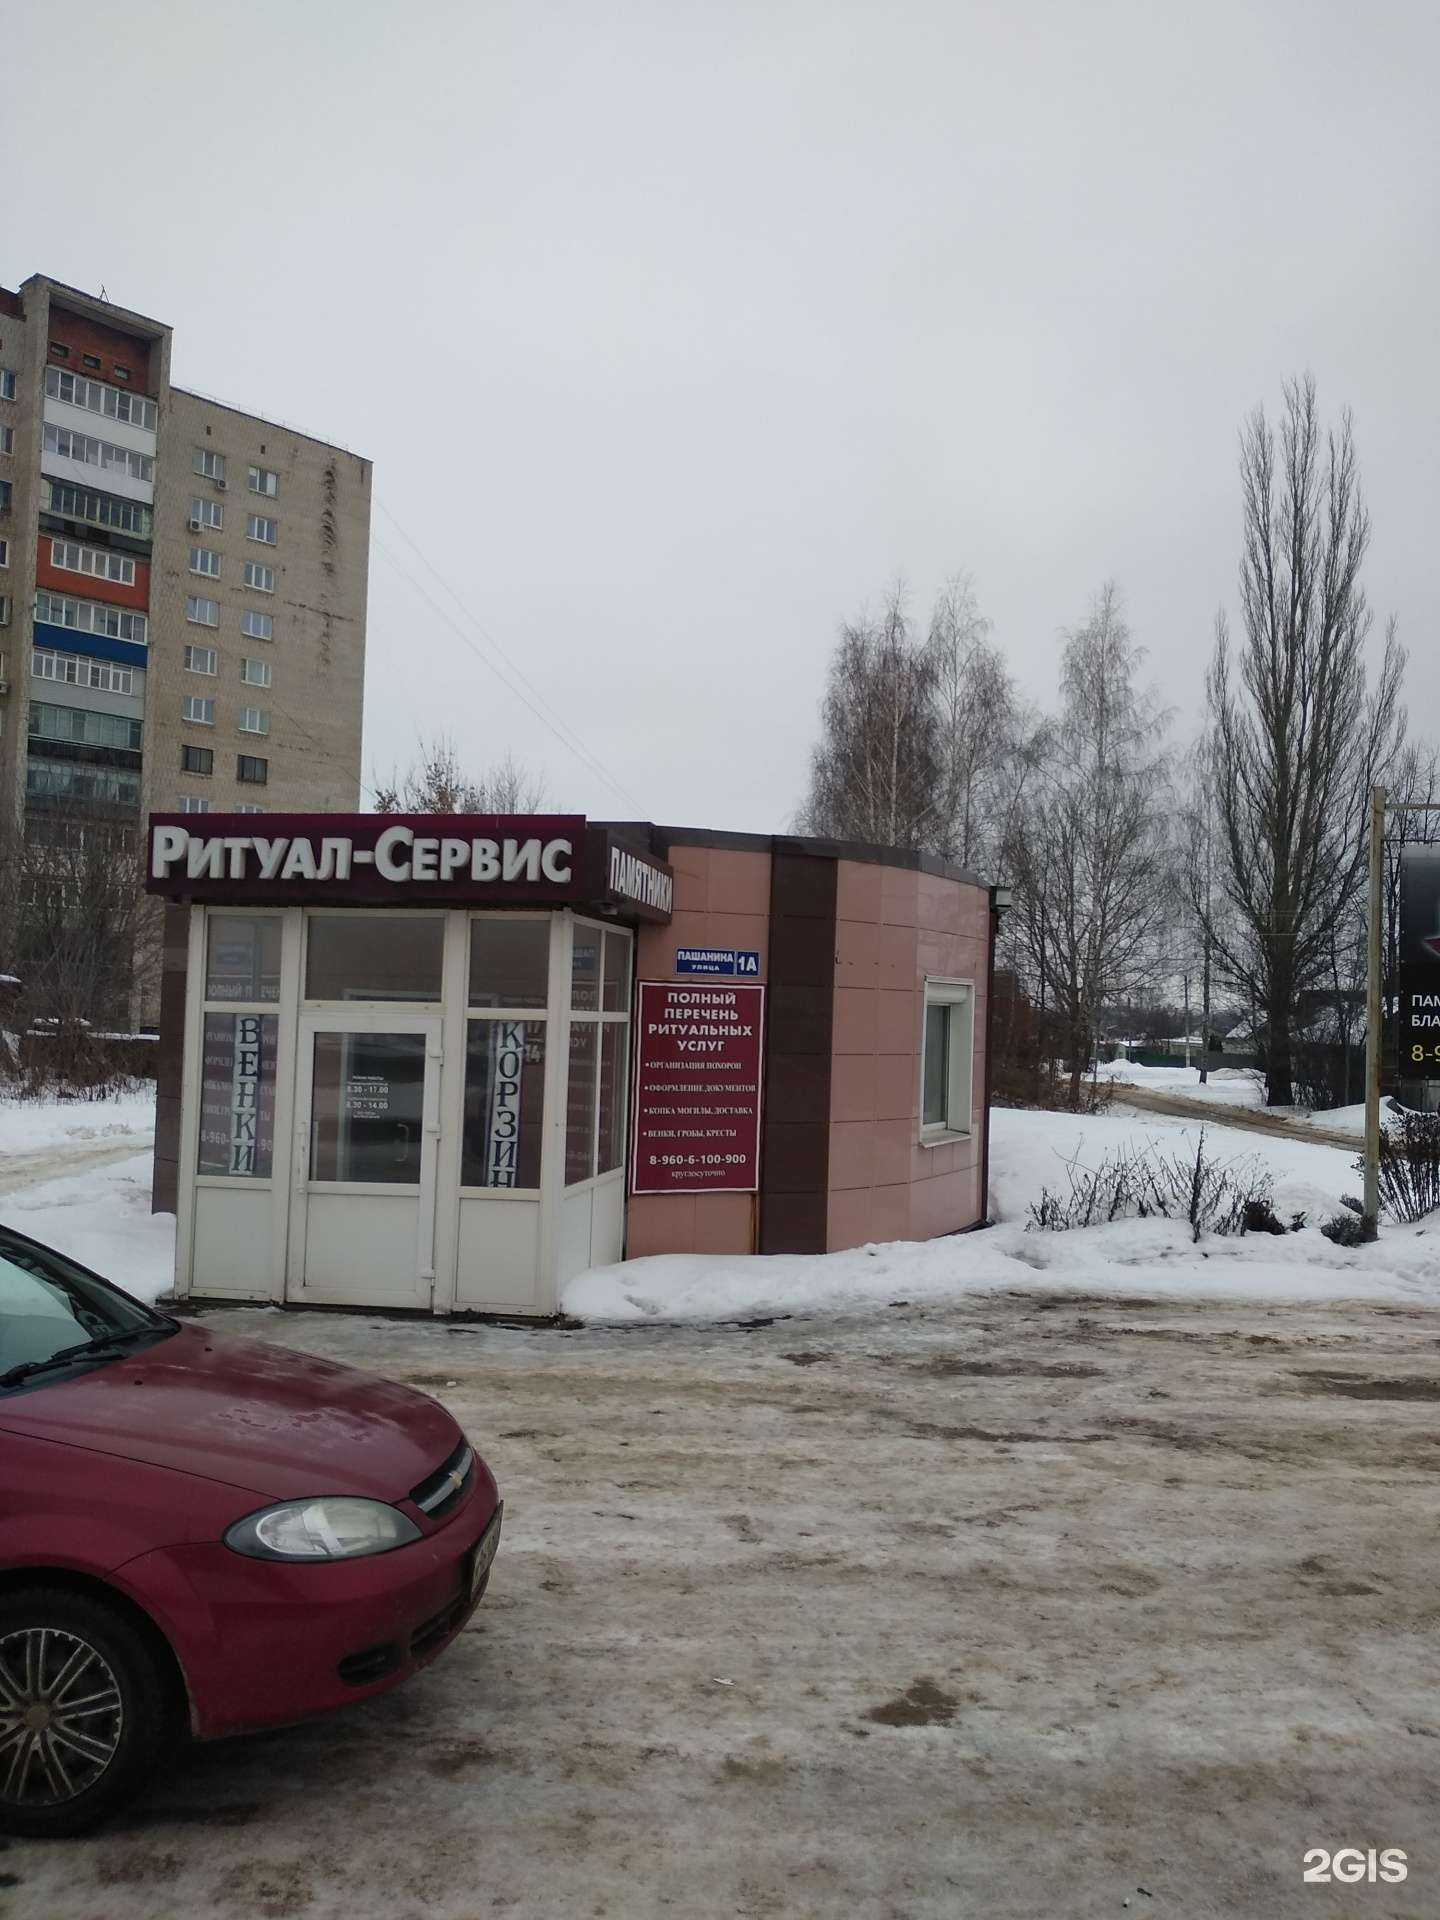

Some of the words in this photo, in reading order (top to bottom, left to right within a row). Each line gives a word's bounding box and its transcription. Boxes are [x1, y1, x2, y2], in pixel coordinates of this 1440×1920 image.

[609, 846, 673, 915] ПАМЯТНИКИ
[738, 955, 757, 972] 1А
[667, 992, 736, 1004] ПОЛНЫЙ
[664, 1008, 739, 1020] ПЕРЕЧЕНЬ
[648, 1023, 752, 1036] РИТУАЛЬНЫХ
[676, 1040, 725, 1052] УСЛУГ
[232, 1018, 261, 1171] ВЕНКИ
[649, 1154, 746, 1165] 8-960-6-100-900
